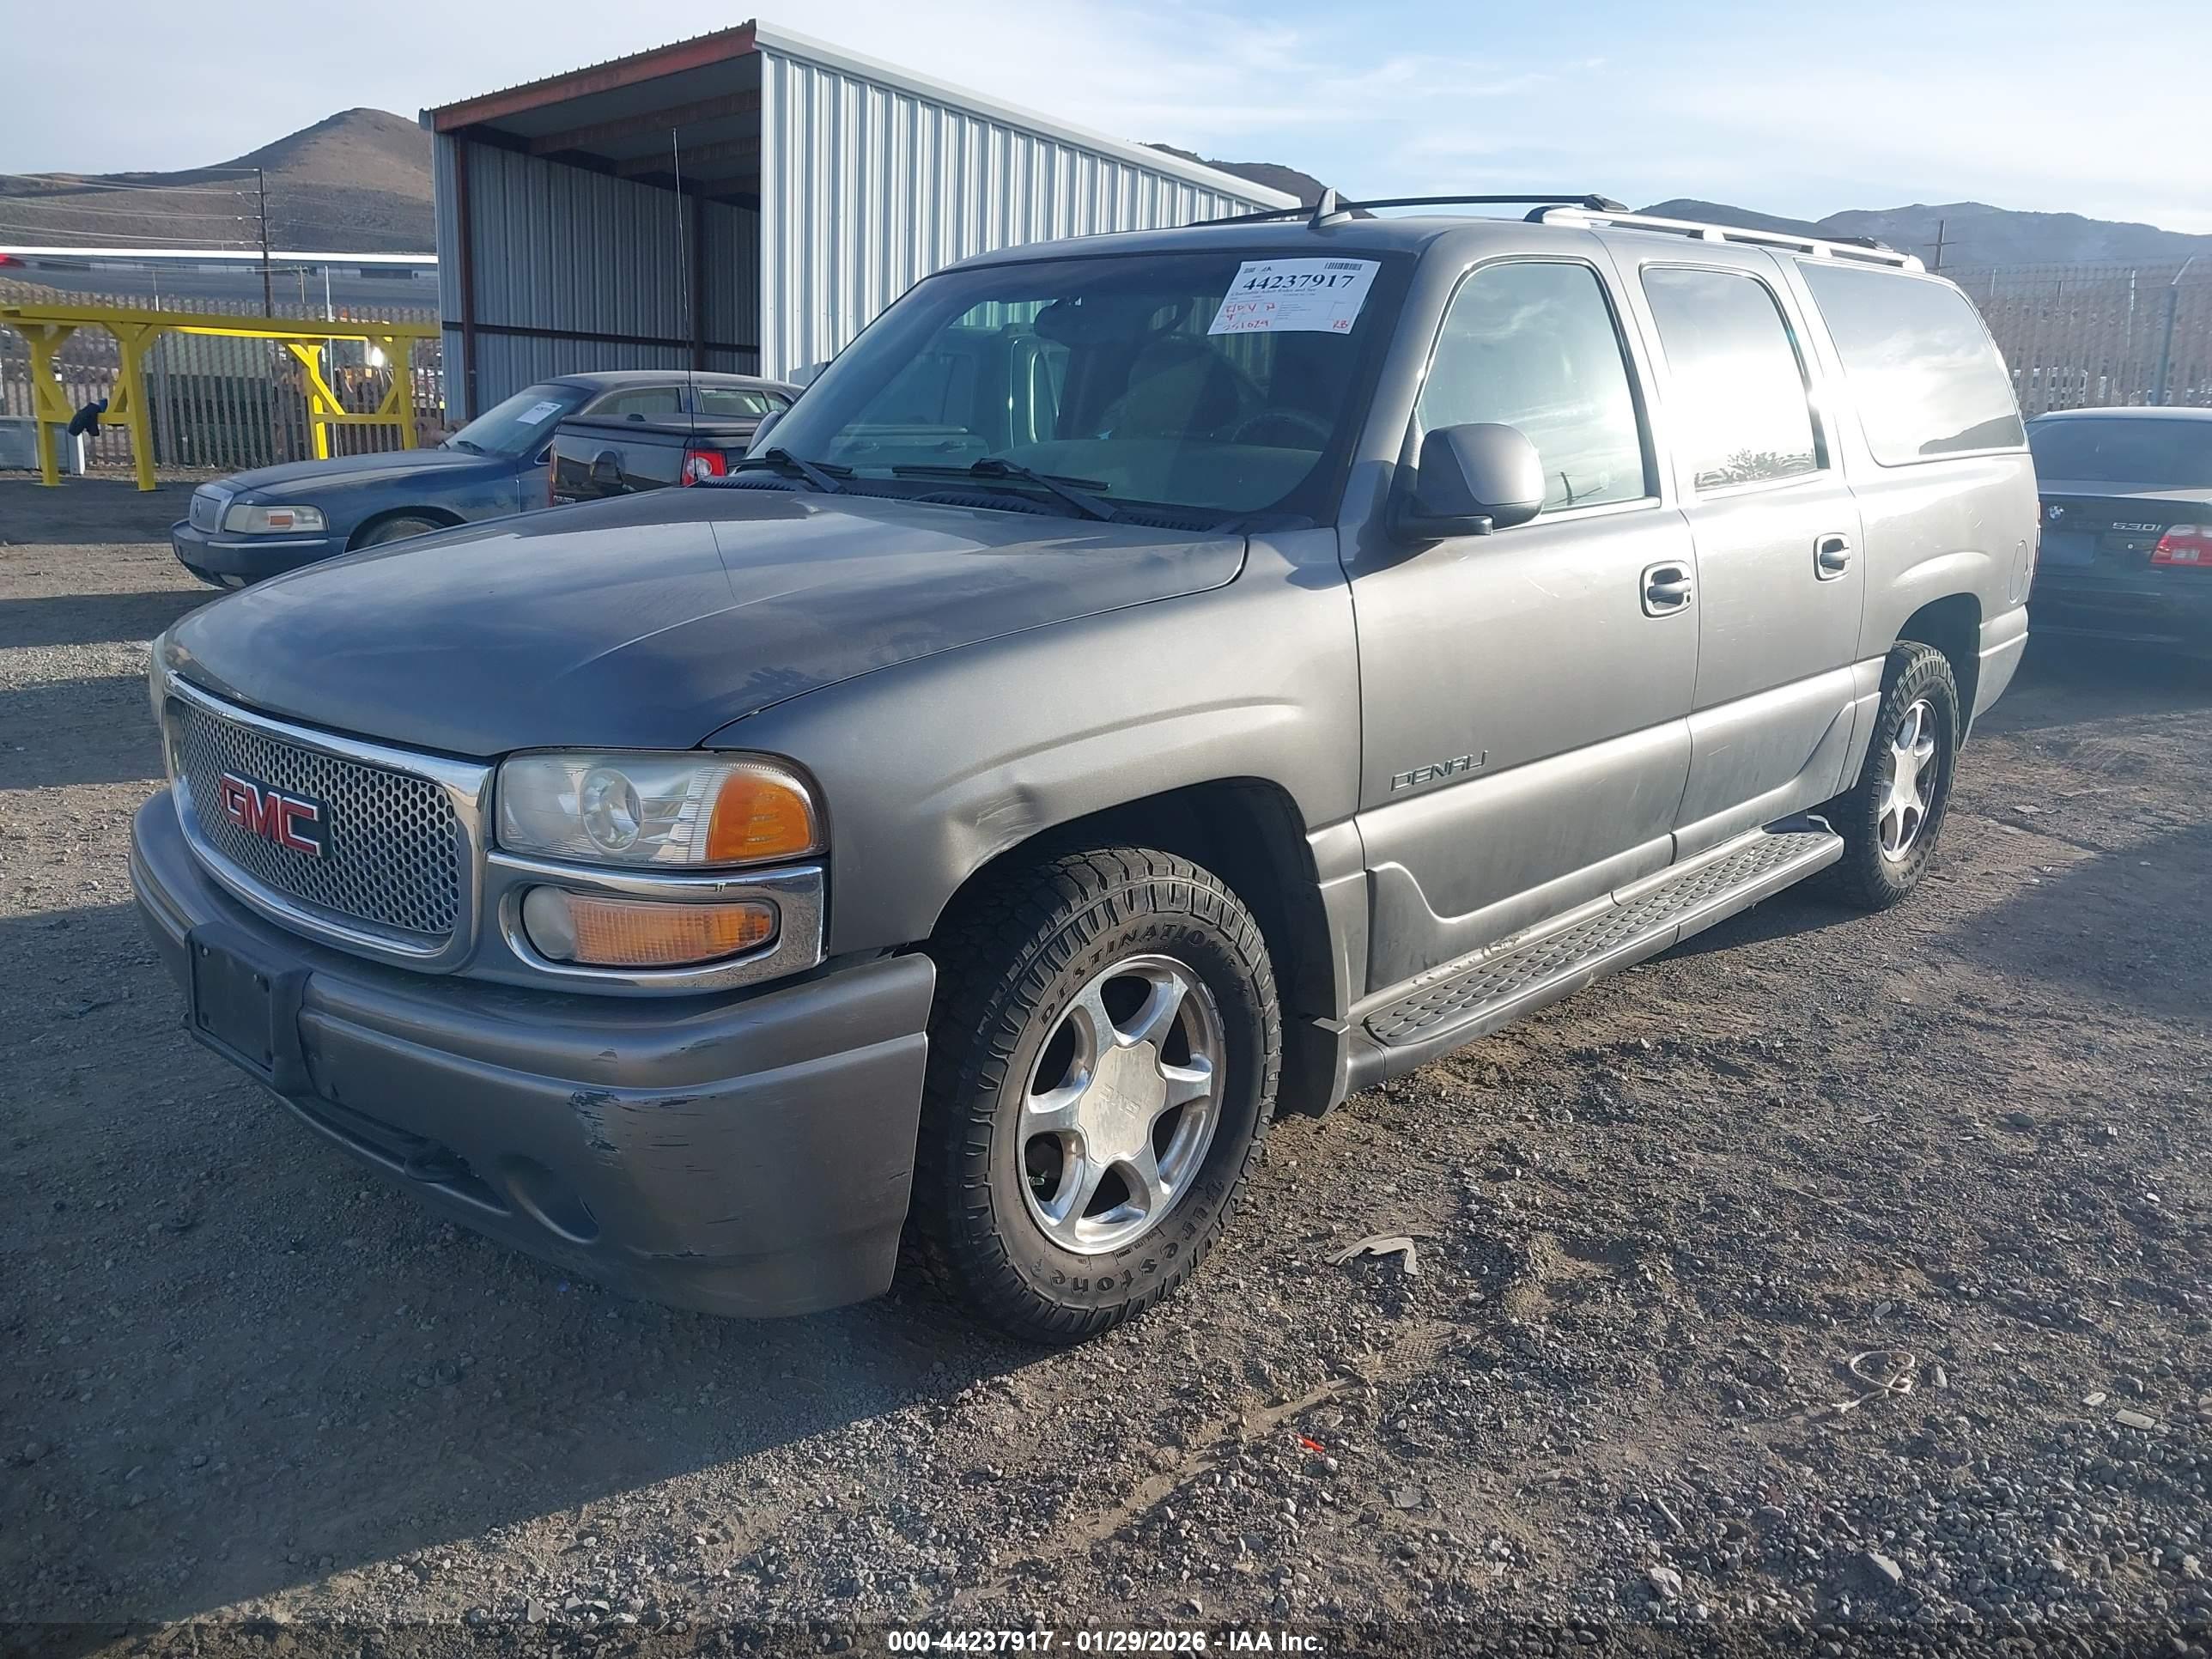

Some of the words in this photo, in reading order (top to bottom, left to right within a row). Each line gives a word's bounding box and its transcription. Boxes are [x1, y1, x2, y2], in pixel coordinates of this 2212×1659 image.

[1243, 273, 1355, 290] 44237917
[1390, 750, 1489, 792] DENALI
[219, 772, 321, 857] GMC
